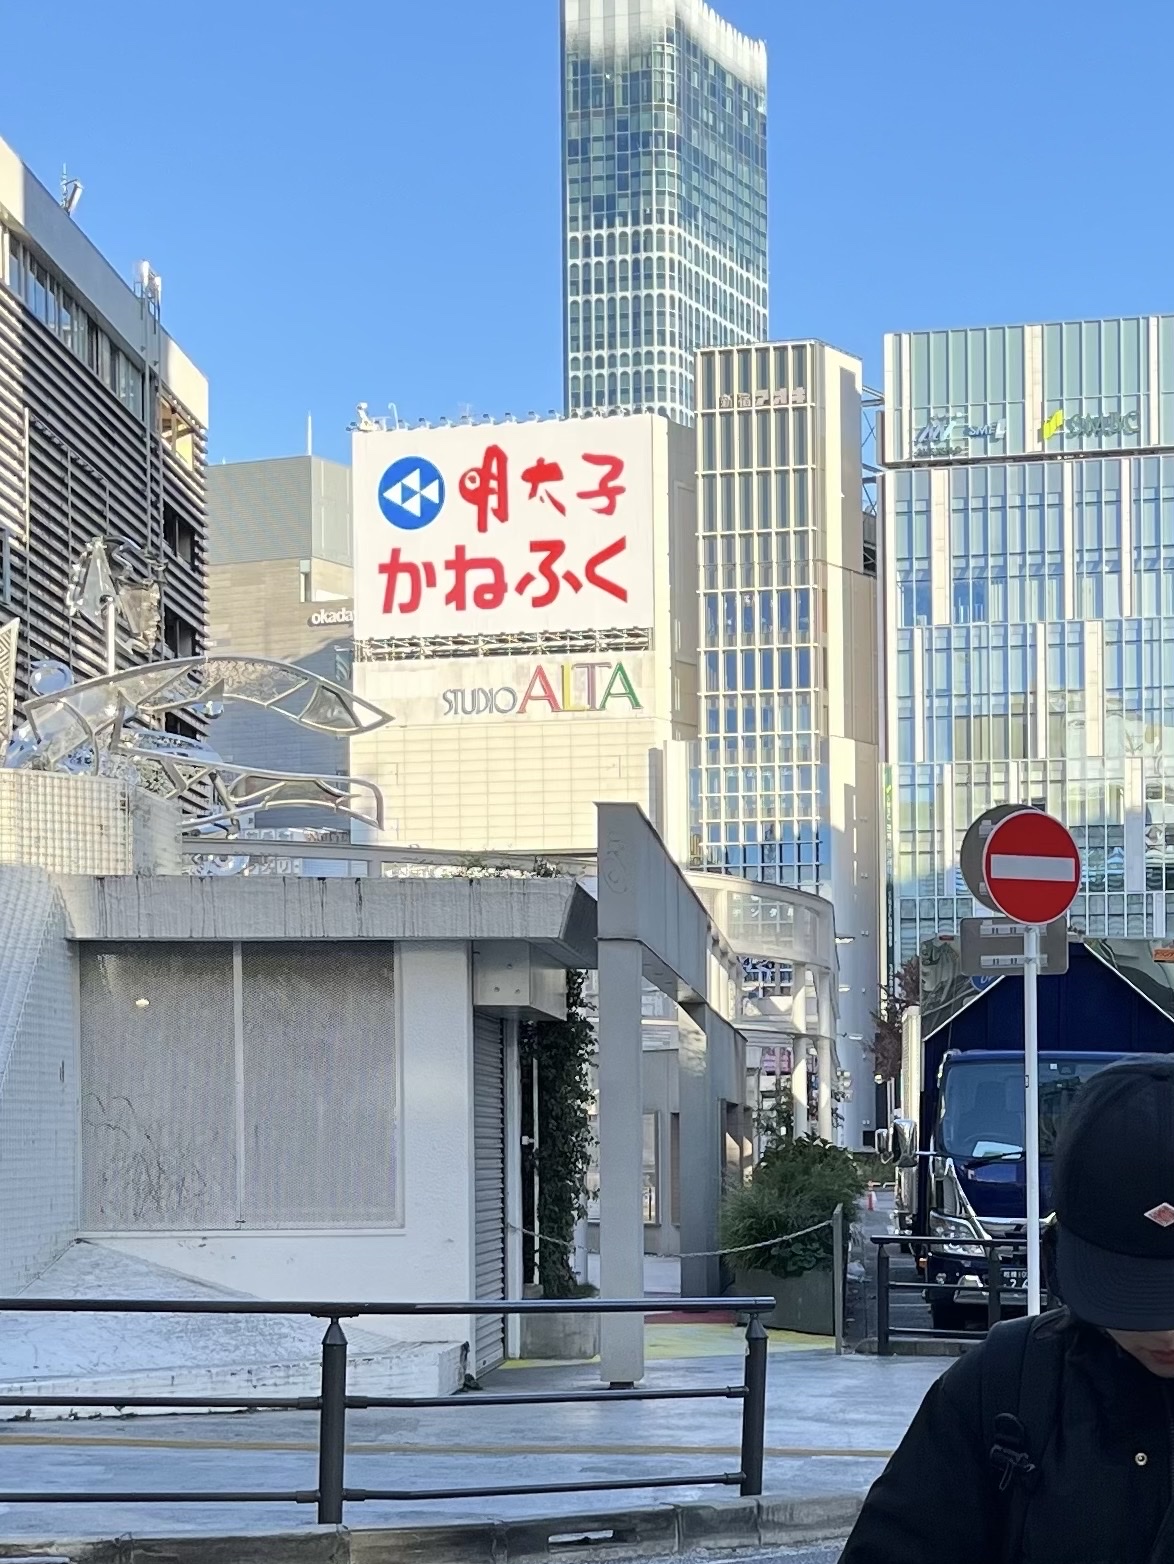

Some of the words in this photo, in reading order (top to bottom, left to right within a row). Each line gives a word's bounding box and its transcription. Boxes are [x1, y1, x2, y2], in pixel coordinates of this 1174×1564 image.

[458, 445, 626, 532] 明太子
[378, 536, 628, 614] かねふく
[443, 687, 518, 715] STUDIO
[519, 661, 643, 714] ALTA
